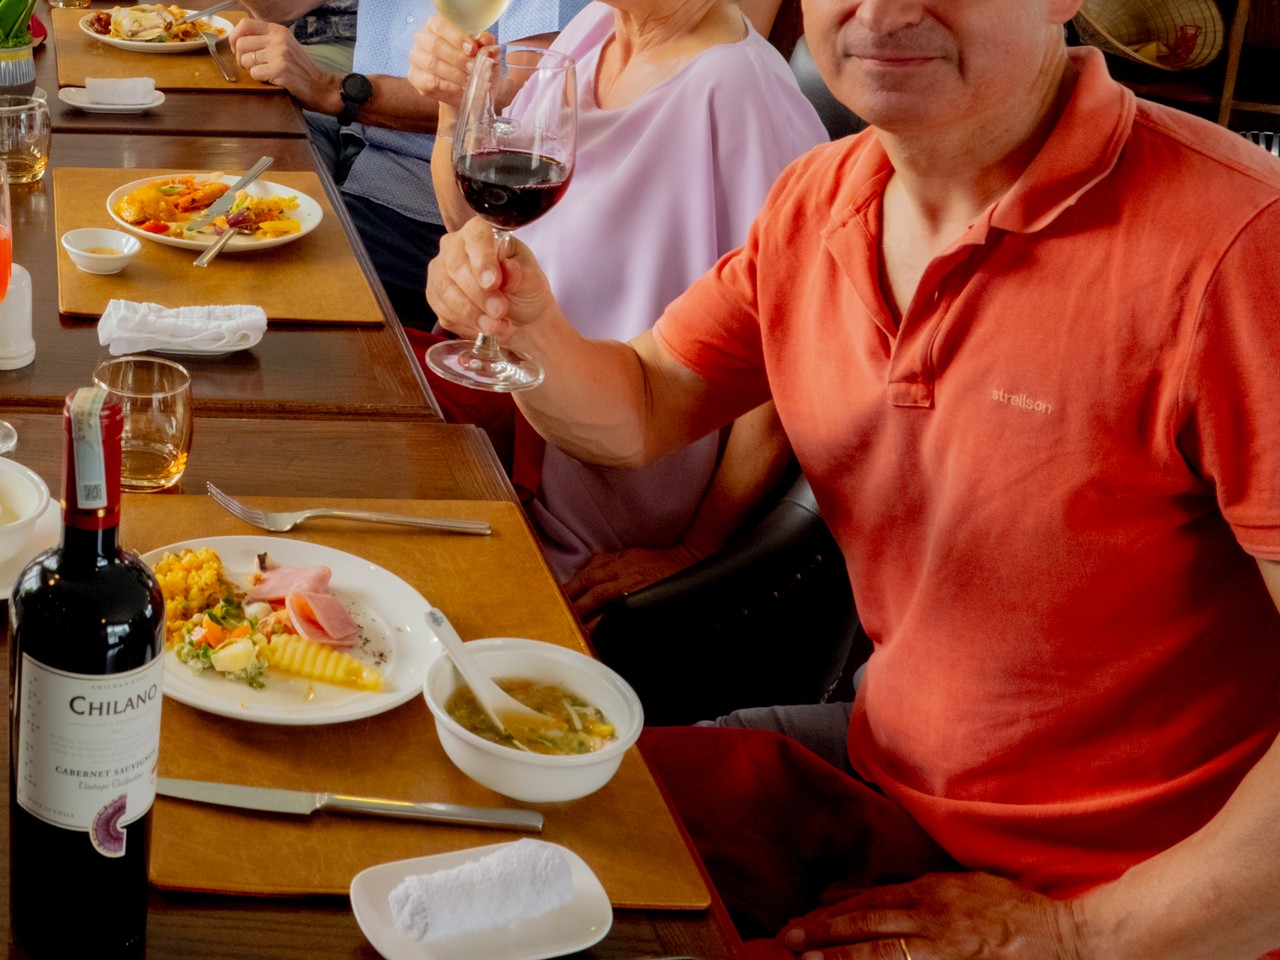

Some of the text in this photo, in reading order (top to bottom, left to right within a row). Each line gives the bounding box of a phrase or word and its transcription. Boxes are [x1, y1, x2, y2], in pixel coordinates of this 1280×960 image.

[991, 389, 1053, 415] strellson
[68, 683, 158, 717] CHILANO
[54, 764, 111, 779] CABERNET
